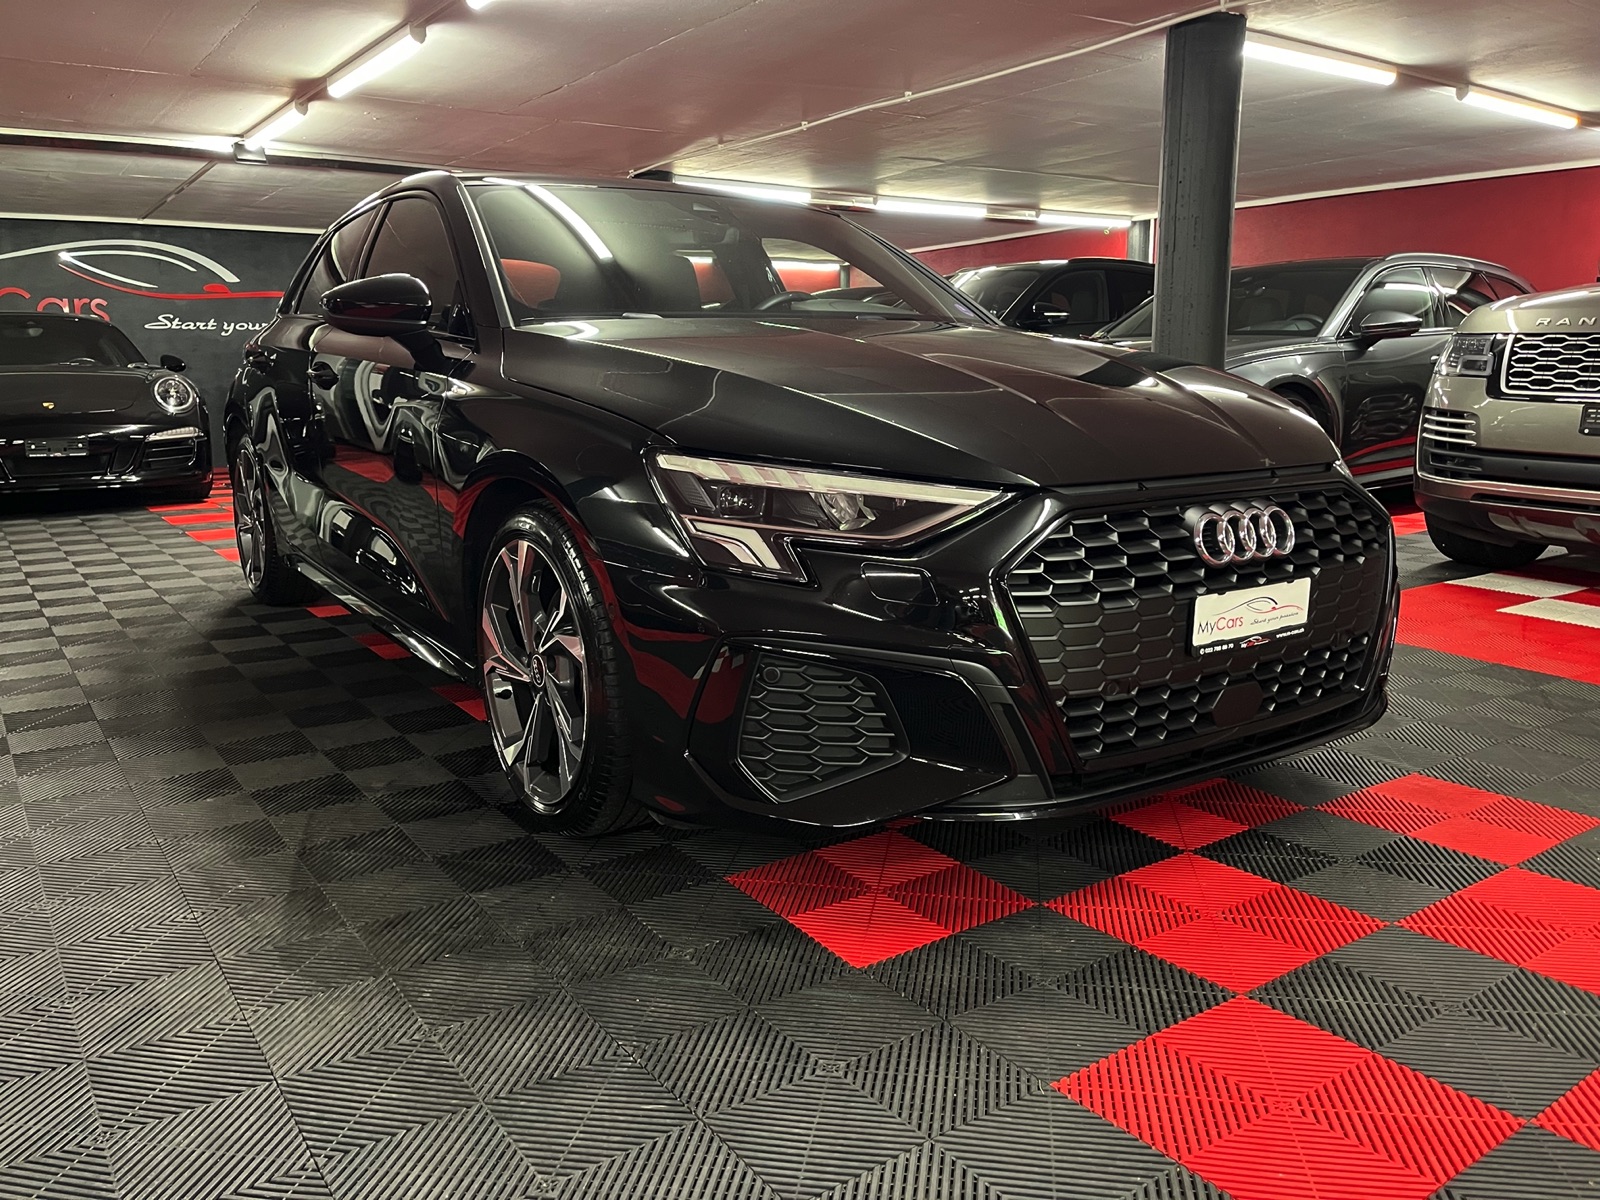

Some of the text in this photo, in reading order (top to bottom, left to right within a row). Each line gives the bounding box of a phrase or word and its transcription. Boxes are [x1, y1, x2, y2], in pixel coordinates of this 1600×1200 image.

[144, 314, 268, 336] Start your
[1535, 316, 1597, 326] RAN
[1197, 616, 1244, 635] MyCars
